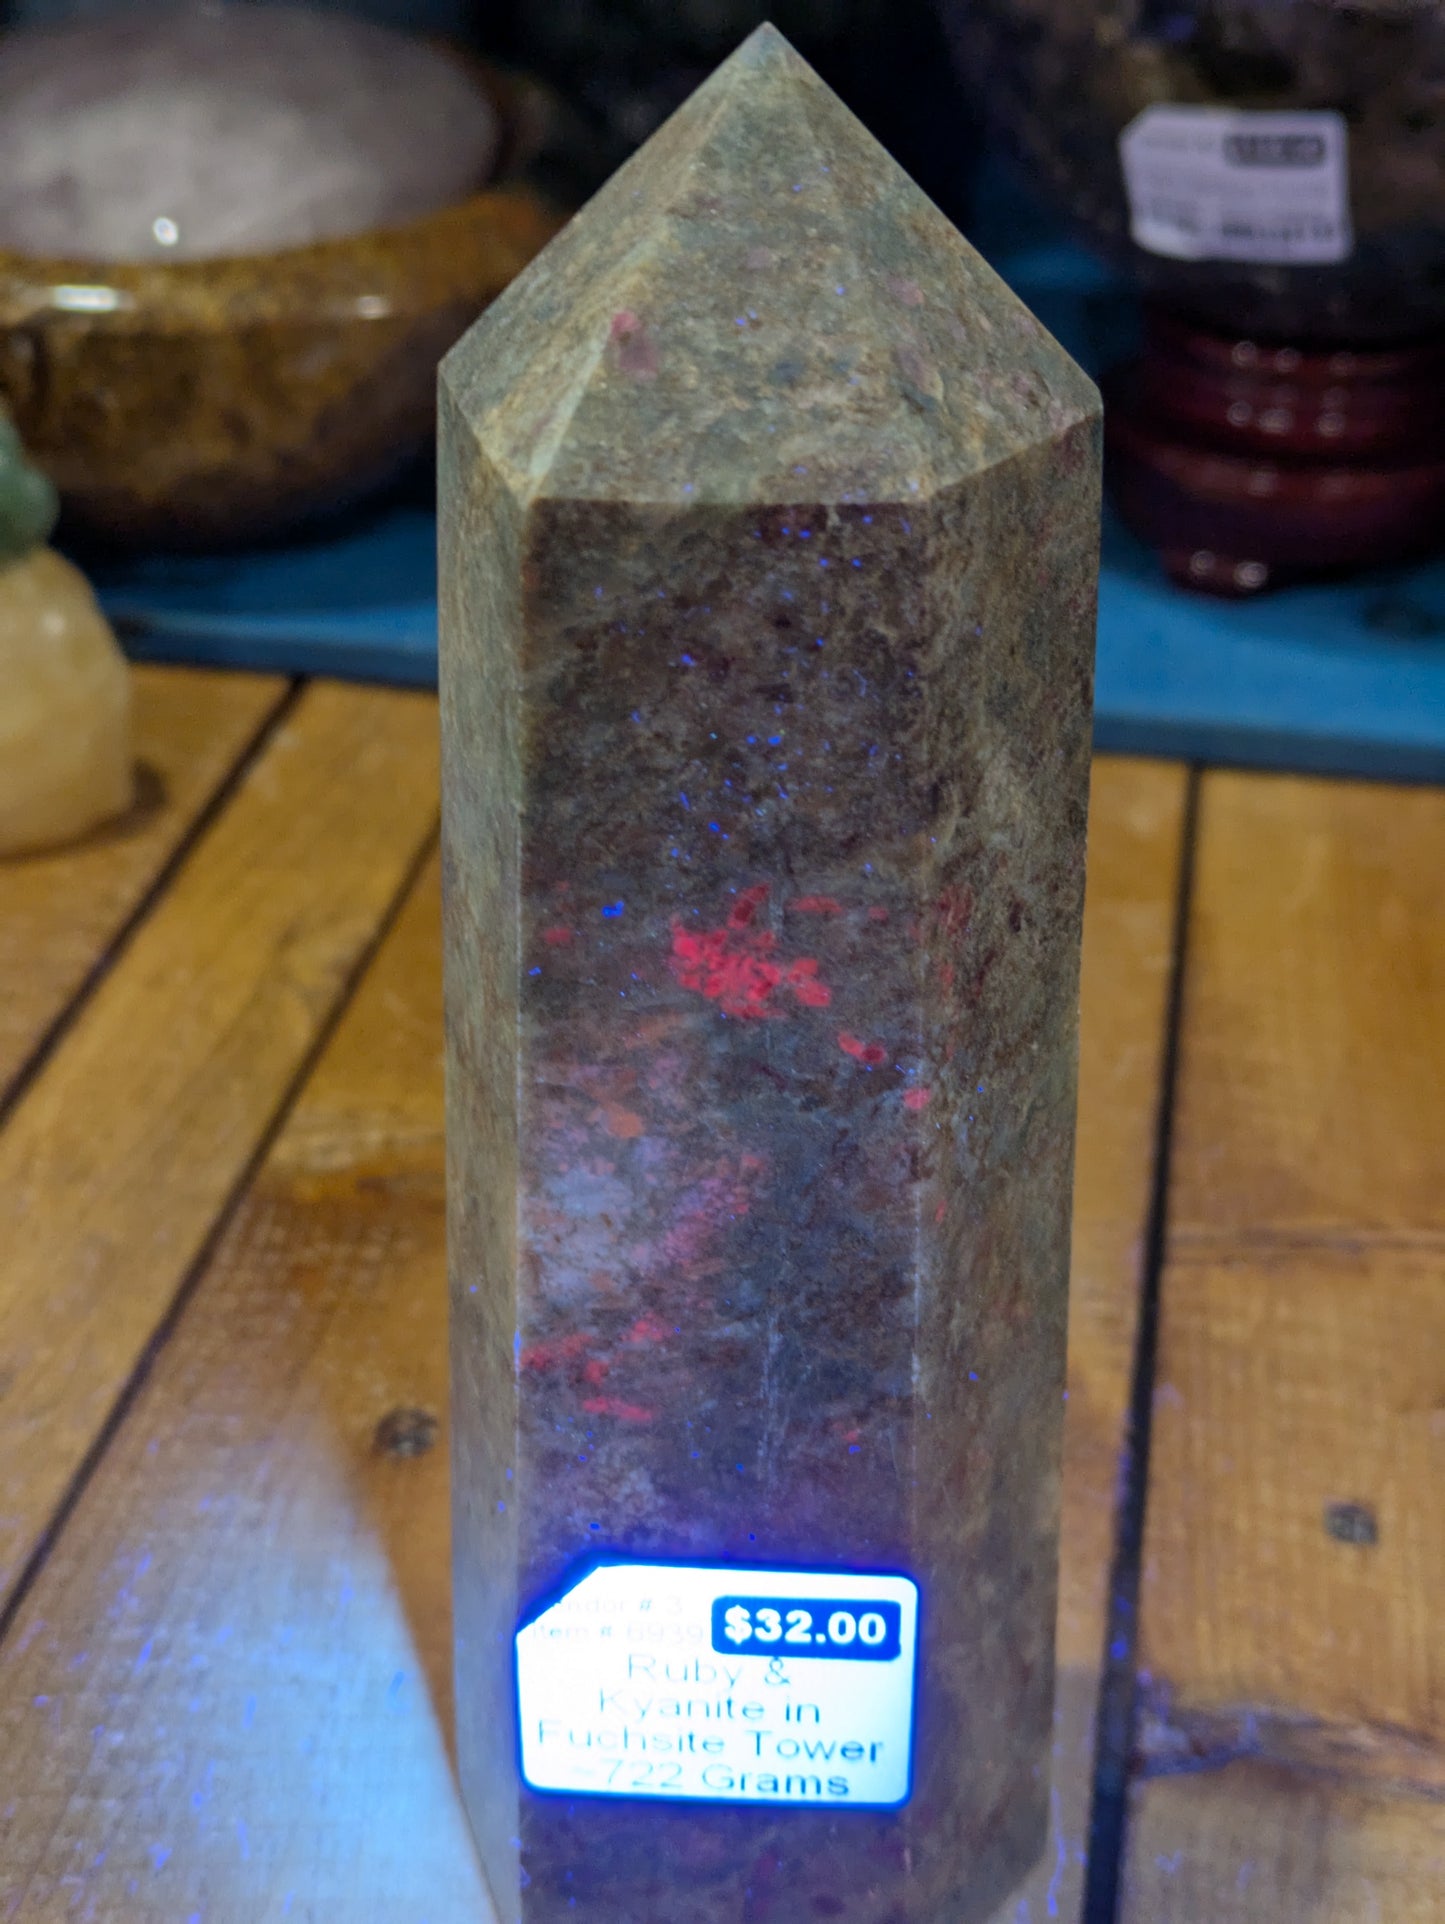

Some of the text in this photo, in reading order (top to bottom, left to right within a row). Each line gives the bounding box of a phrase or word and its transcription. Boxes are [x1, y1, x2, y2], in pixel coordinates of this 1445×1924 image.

[724, 1604, 886, 1645] $32.00
[627, 1653, 791, 1689] Ruby &
[599, 1687, 820, 1725] Kyanite in
[537, 1719, 884, 1764] Fuchsite Tower
[701, 1764, 851, 1797] Grams
